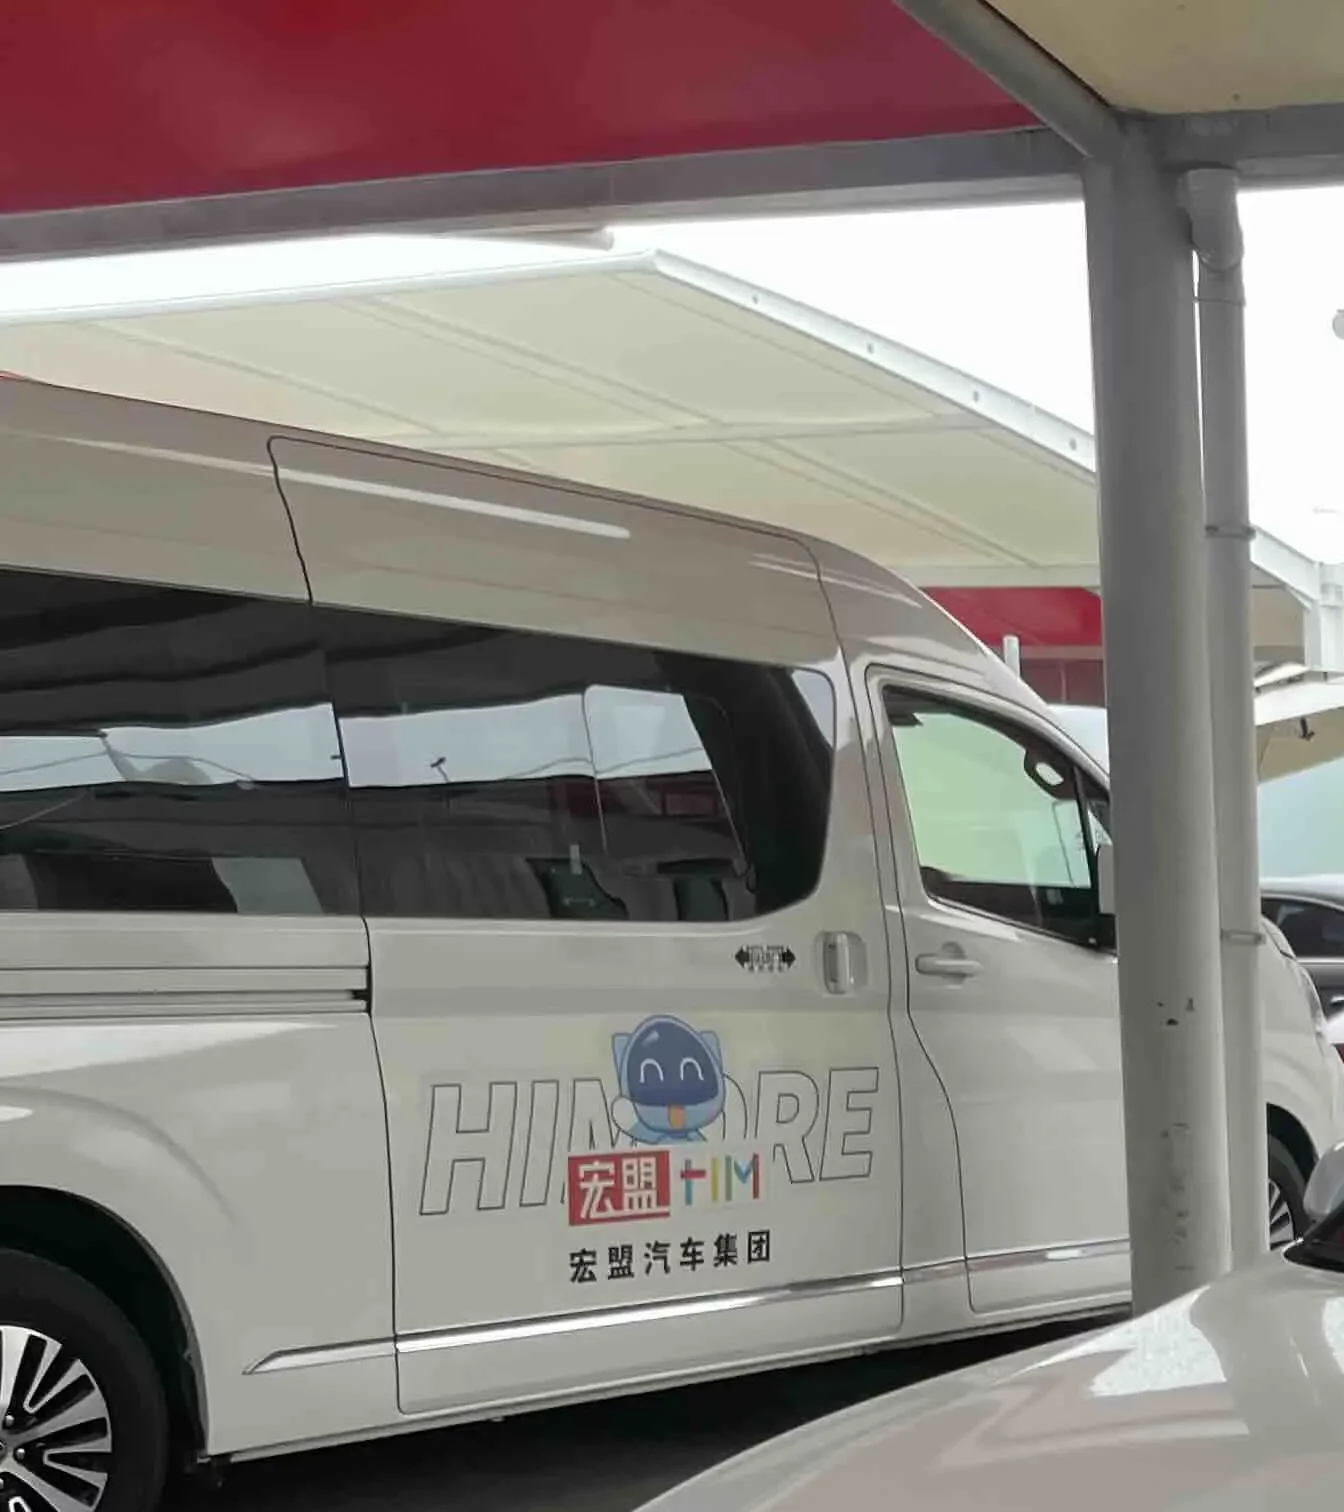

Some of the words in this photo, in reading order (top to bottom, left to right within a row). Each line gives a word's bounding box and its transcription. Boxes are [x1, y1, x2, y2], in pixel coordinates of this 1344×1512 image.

[577, 1155, 660, 1219] 宏盟
[569, 1229, 771, 1284] 宏盟汽车集团
